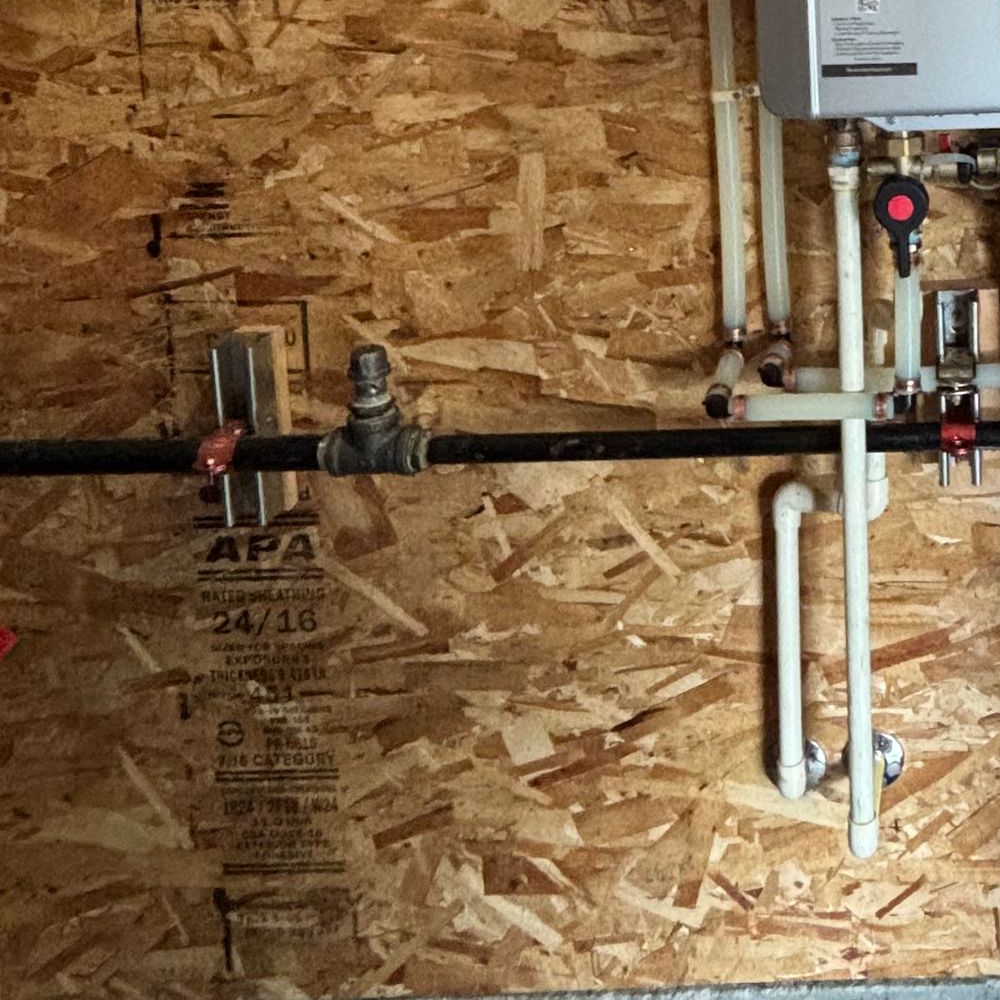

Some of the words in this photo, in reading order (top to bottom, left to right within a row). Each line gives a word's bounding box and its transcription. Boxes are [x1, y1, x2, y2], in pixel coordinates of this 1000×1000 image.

[206, 533, 315, 563] APA
[213, 607, 318, 639] 24/16
[252, 750, 335, 767] CATEGORY
